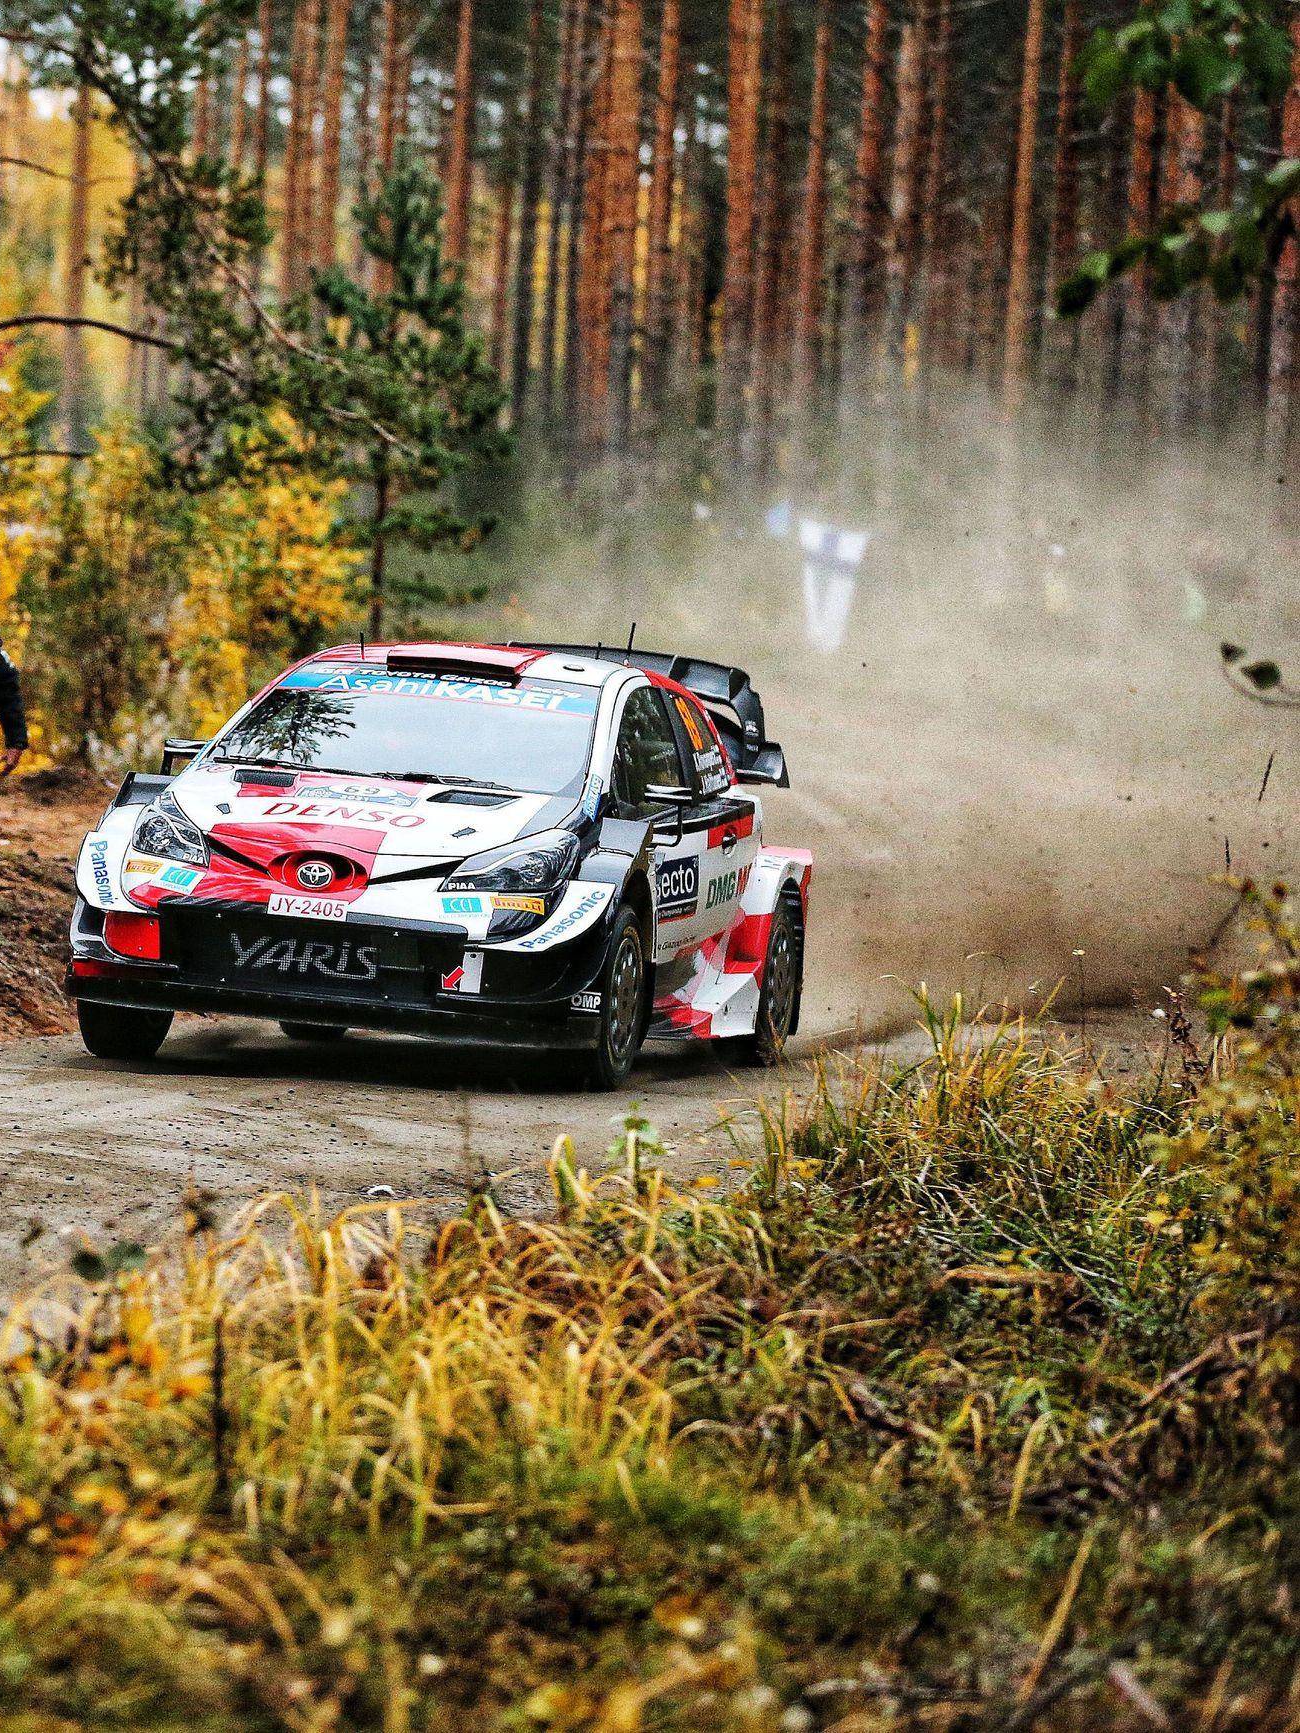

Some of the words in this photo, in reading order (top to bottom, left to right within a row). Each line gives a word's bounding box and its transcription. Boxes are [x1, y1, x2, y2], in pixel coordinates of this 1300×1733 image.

[359, 669, 437, 680] TOYOTA
[440, 674, 513, 688] GAZOO
[318, 674, 564, 710] AsahiKASEI
[343, 785, 381, 795] 69
[262, 802, 425, 828] DENSO
[182, 852, 204, 864] PIAA
[89, 840, 119, 906] Panasonic
[447, 882, 476, 891] PIAA
[705, 870, 736, 910] DMG
[271, 897, 345, 918] JY-2405
[493, 897, 542, 912] PIRELLI
[518, 890, 606, 949] Panasonic
[571, 993, 601, 1010] OMP
